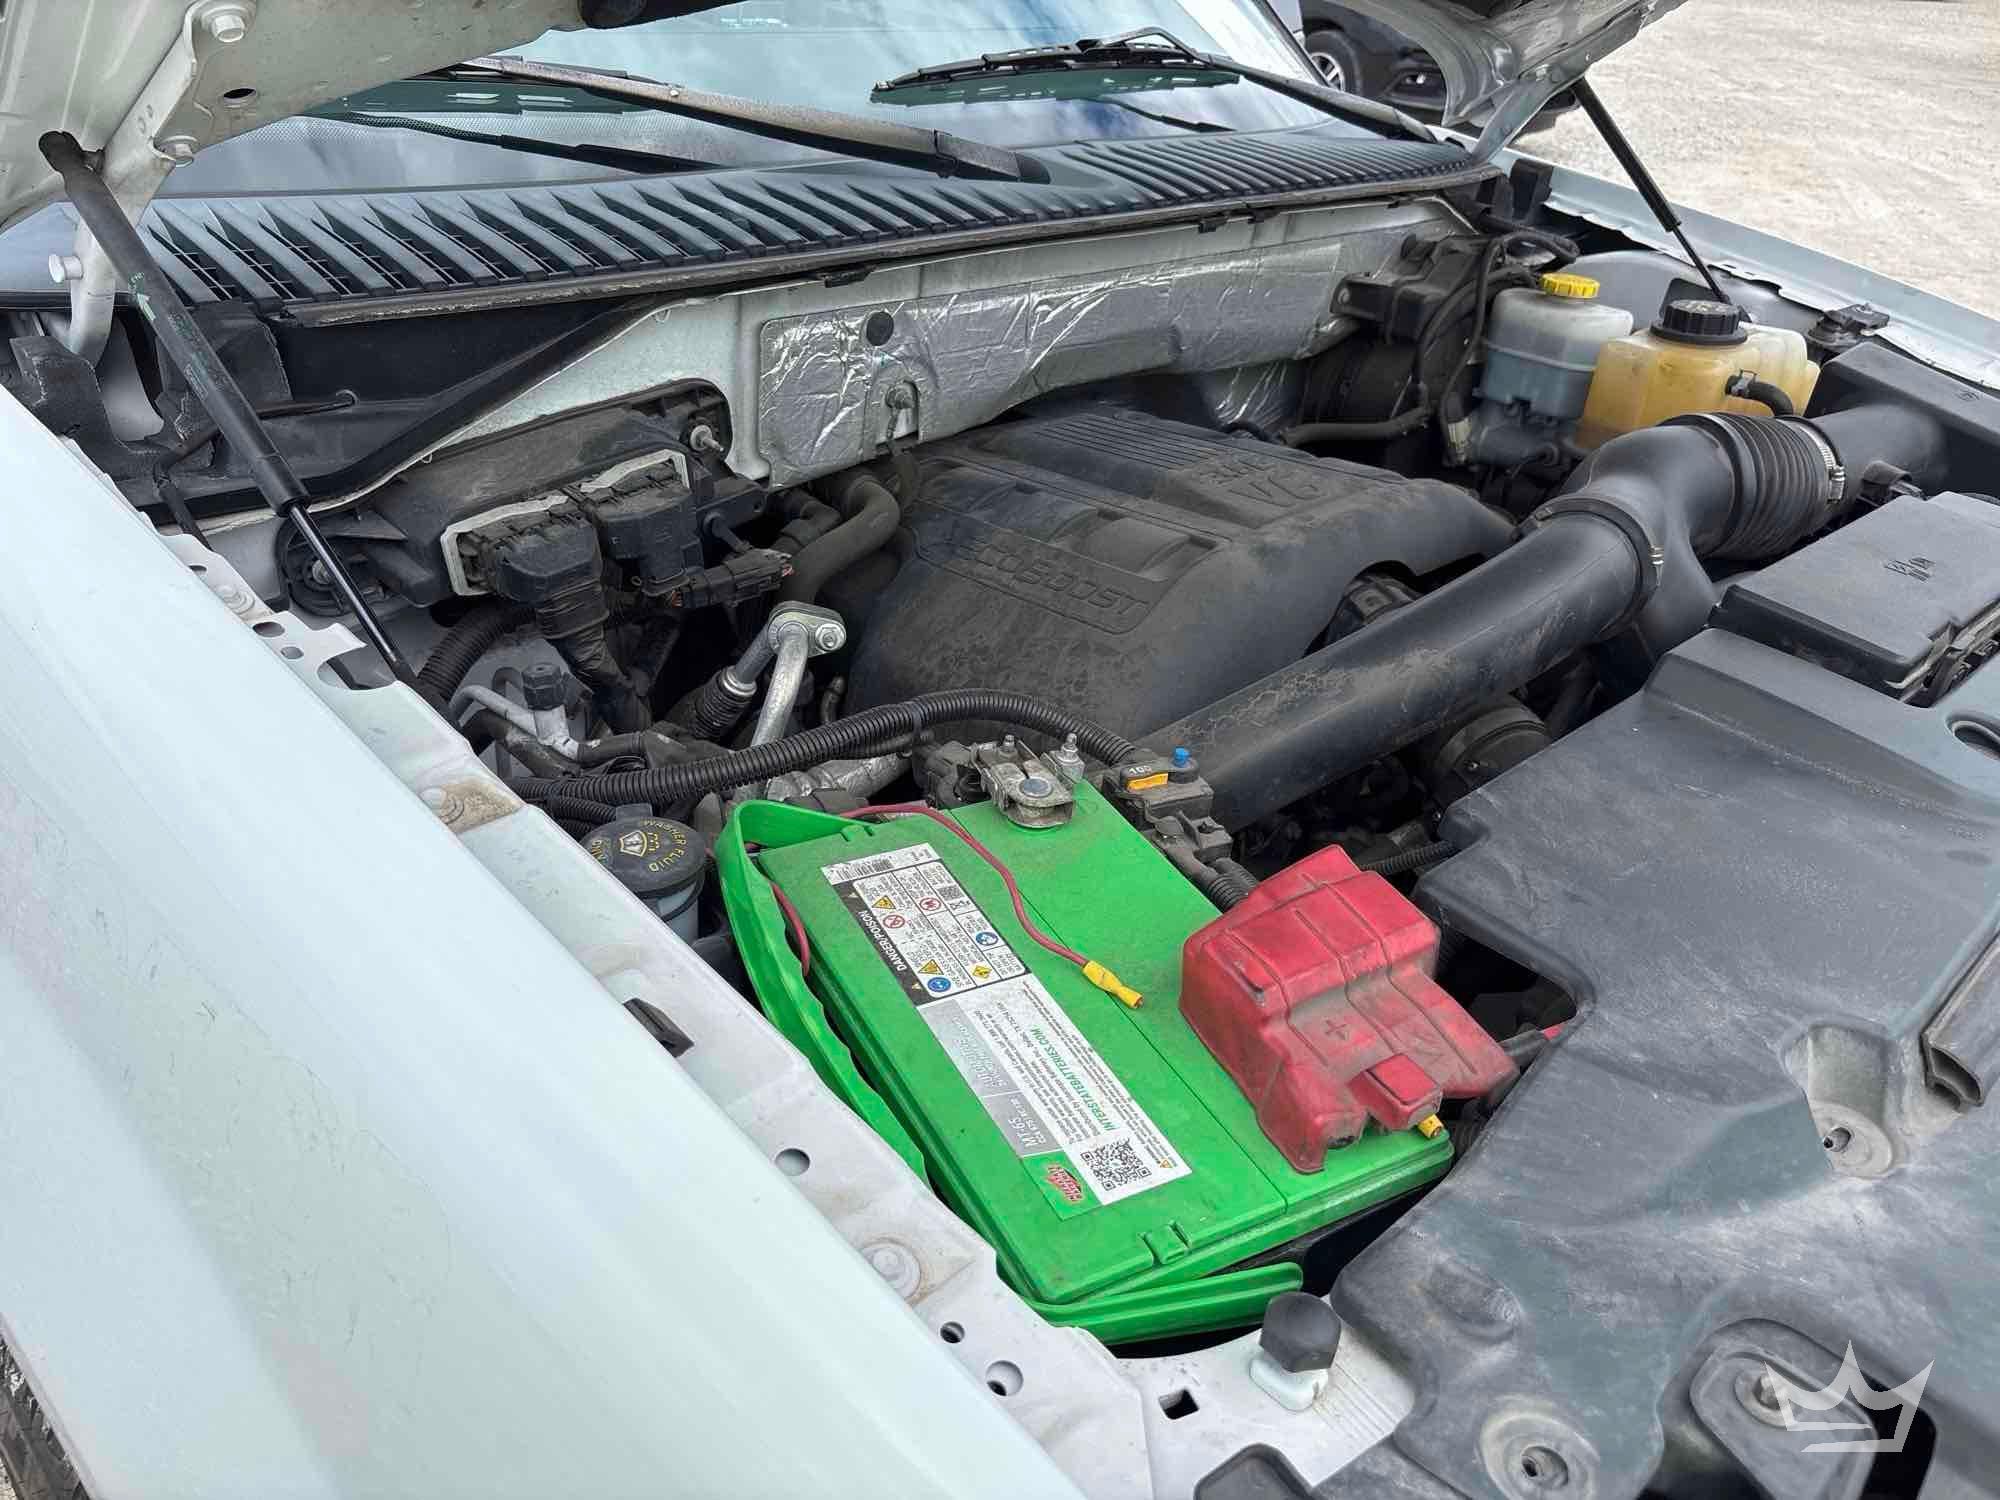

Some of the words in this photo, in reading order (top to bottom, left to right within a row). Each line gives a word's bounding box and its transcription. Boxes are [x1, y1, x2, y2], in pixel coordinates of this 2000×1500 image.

[640, 819, 687, 847] WASHER
[648, 848, 685, 872] FLUID
[857, 909, 908, 971] DANGER/POISON
[1028, 1027, 1117, 1132] INTERSTATEBATTERIES.COM
[1007, 1115, 1038, 1148] MT-65
